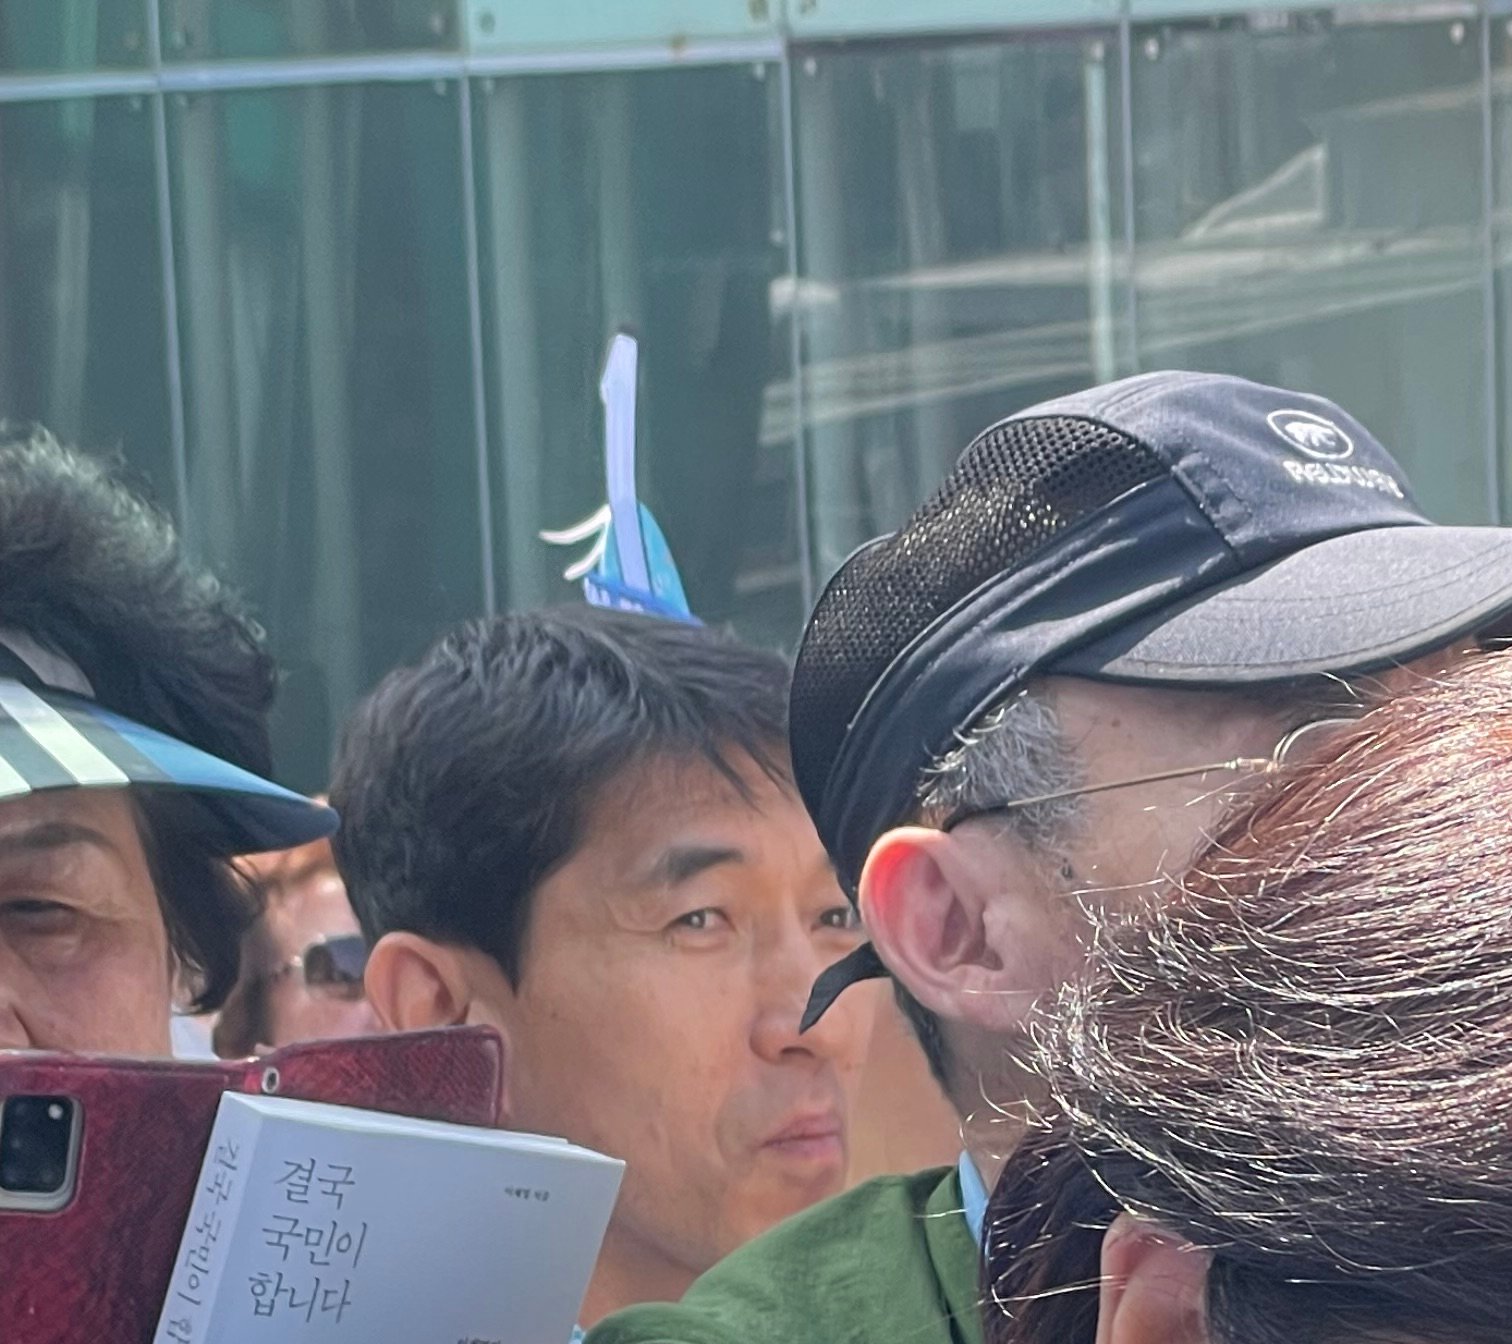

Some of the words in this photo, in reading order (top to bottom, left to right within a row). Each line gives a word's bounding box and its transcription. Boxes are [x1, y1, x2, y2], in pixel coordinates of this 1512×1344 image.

[274, 1157, 356, 1210] 결국
[177, 1211, 222, 1306] 국민이
[262, 1214, 368, 1269] 국민이
[248, 1271, 352, 1324] 합니다
